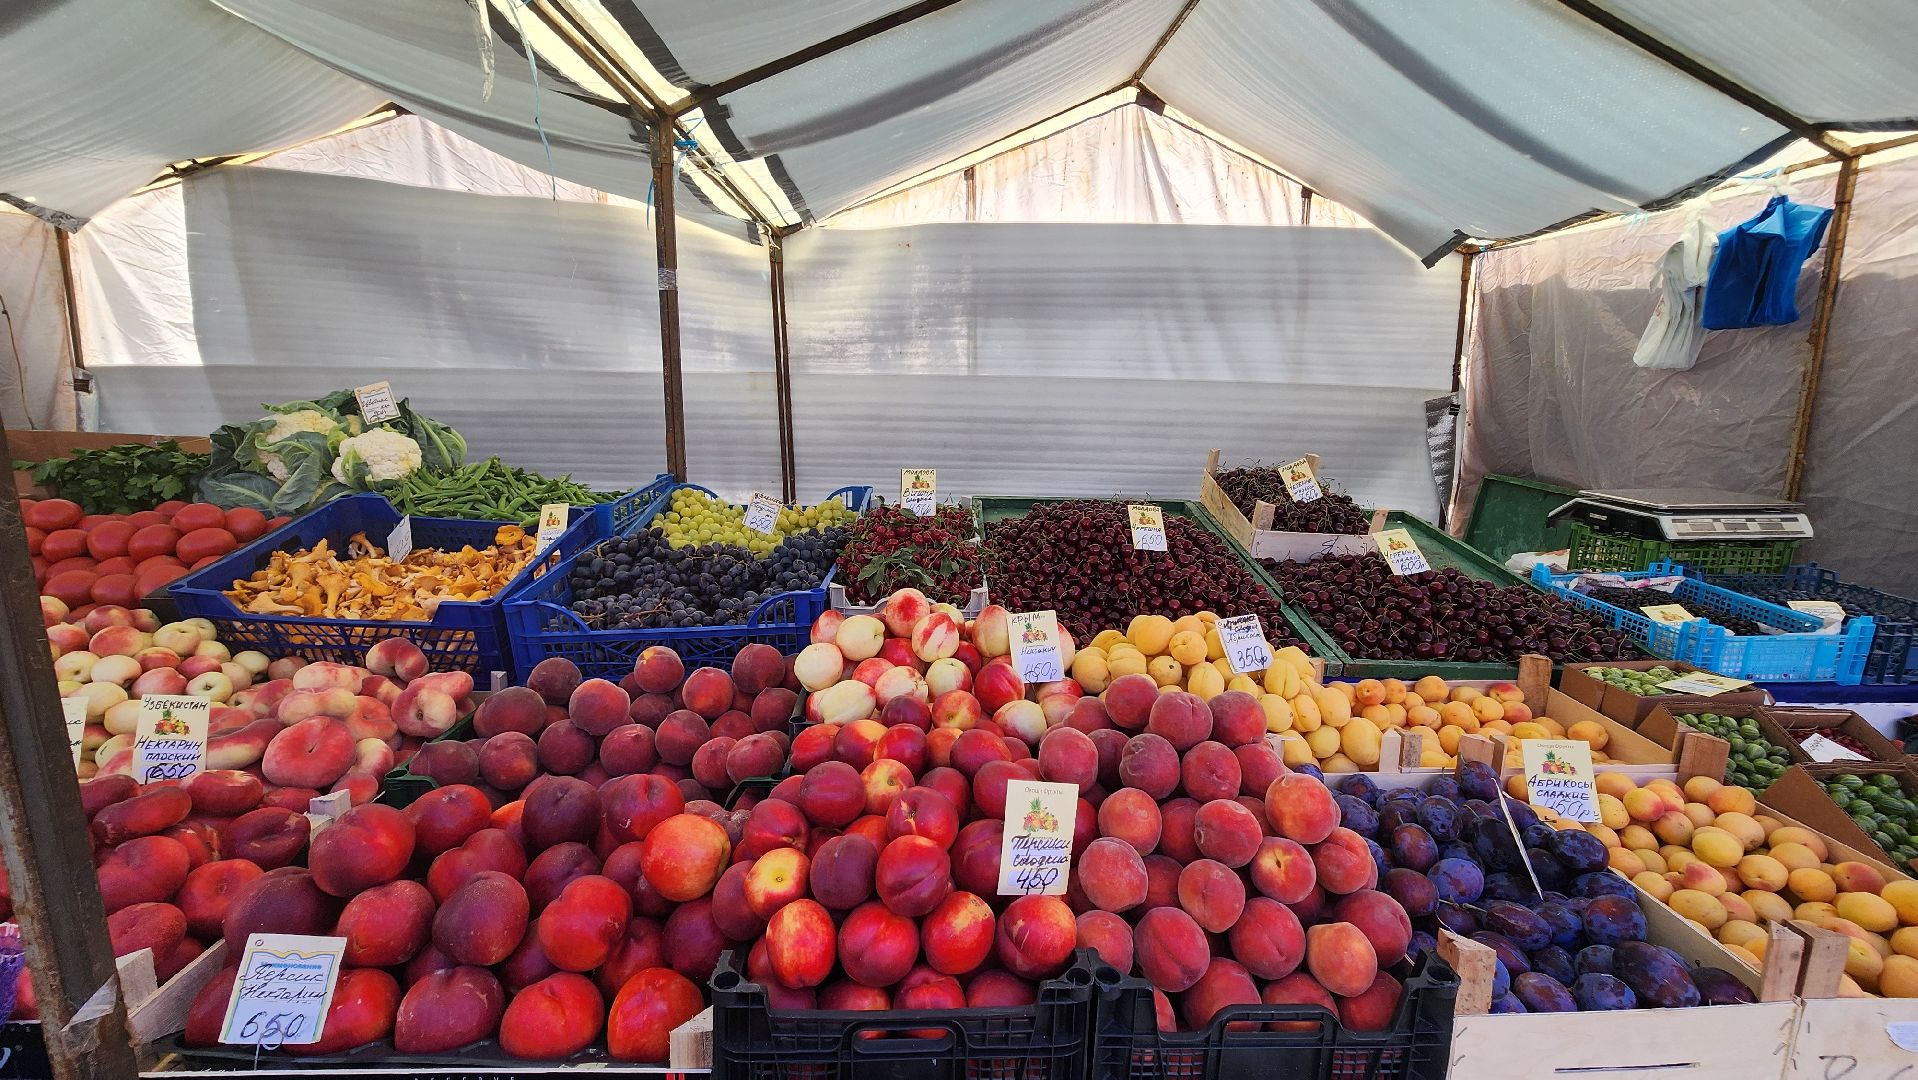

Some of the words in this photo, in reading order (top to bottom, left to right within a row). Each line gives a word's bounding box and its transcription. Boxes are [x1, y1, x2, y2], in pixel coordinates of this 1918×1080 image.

[1011, 612, 1041, 625] КРЫМ
[143, 696, 208, 711] УЗБЕКИСТАН
[1527, 774, 1593, 790] АБРИКОСЫ
[1536, 790, 1590, 801] СЛАДКИЕ
[239, 1011, 305, 1039] 650
